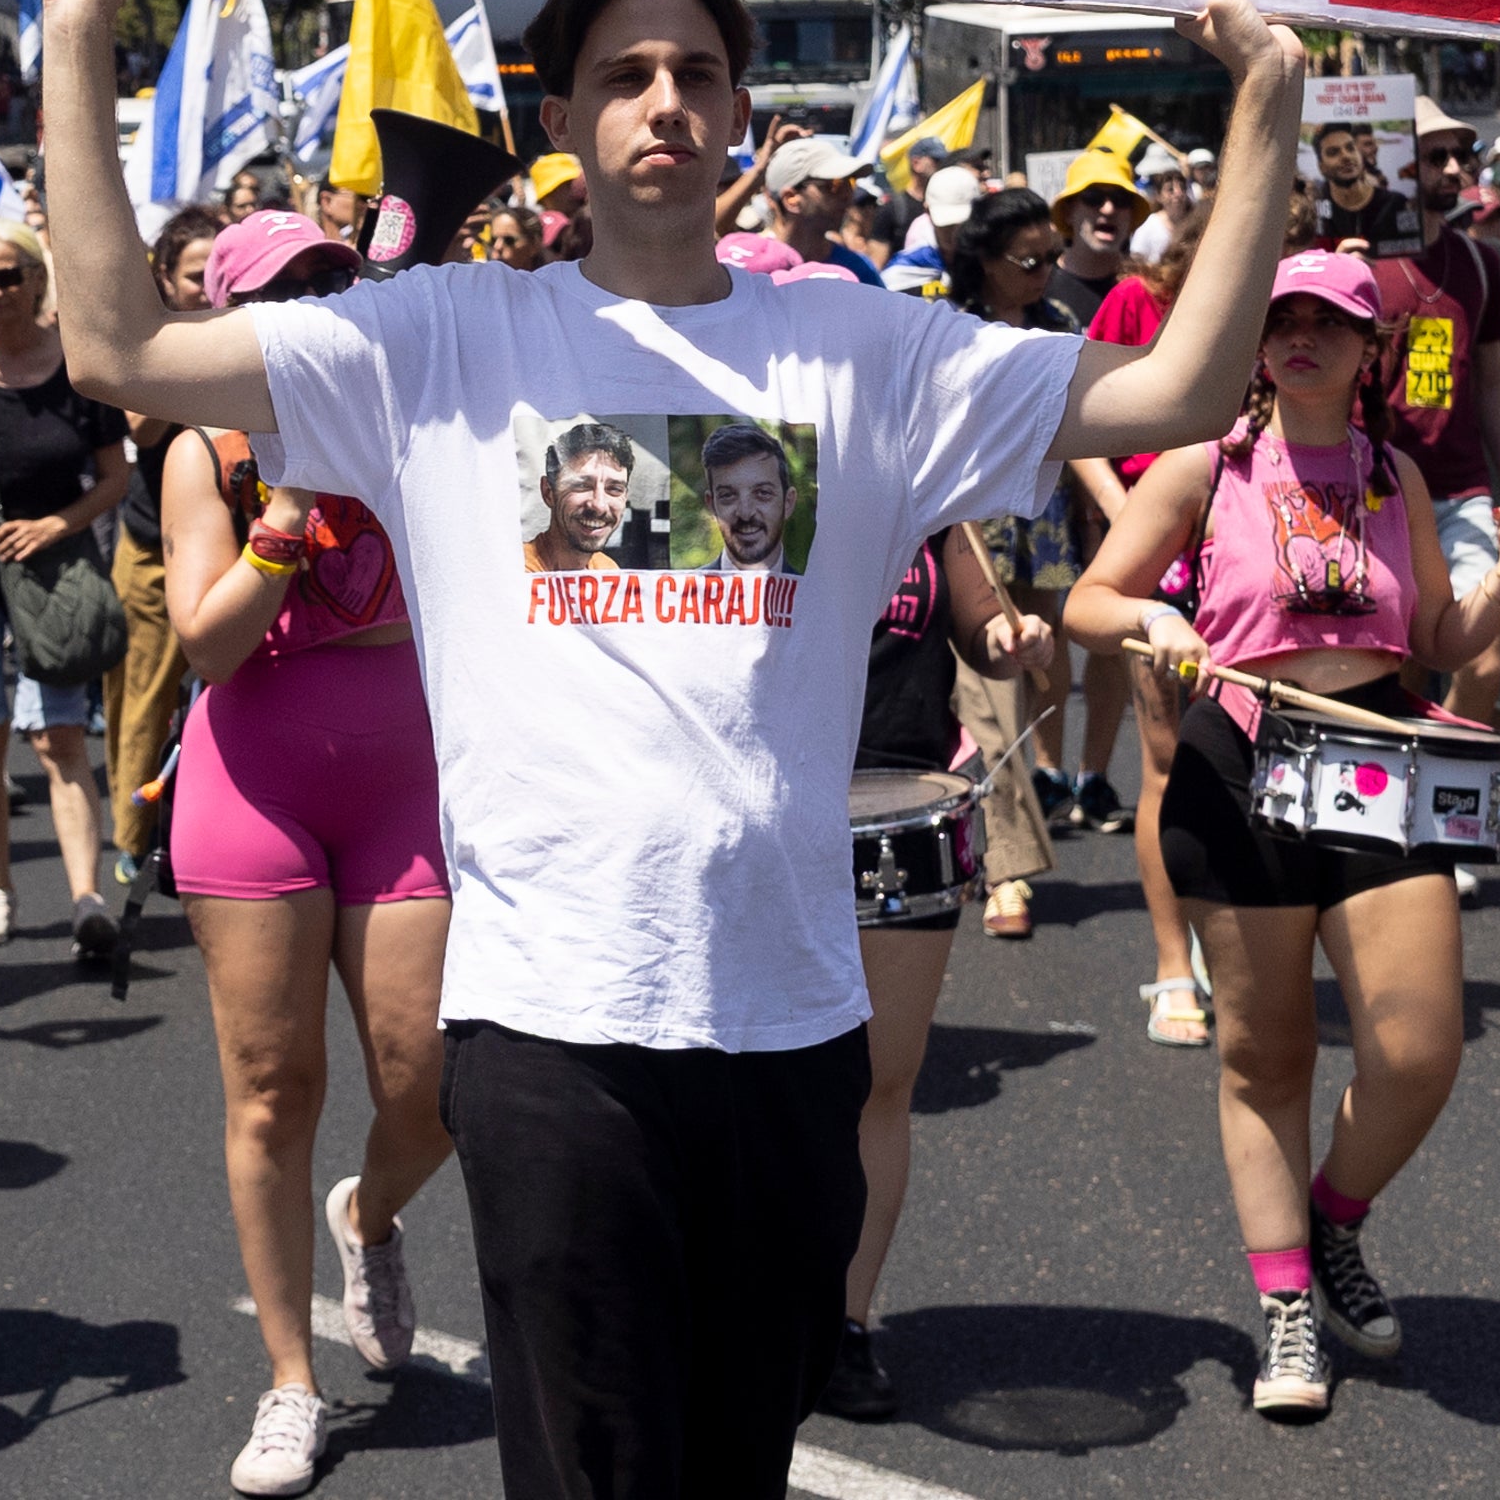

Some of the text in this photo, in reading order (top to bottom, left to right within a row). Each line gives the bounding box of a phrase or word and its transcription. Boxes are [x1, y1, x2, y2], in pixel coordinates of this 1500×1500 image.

[527, 574, 798, 628] FUERZA CARAJO!!!
[1437, 791, 1476, 812] Stagg
